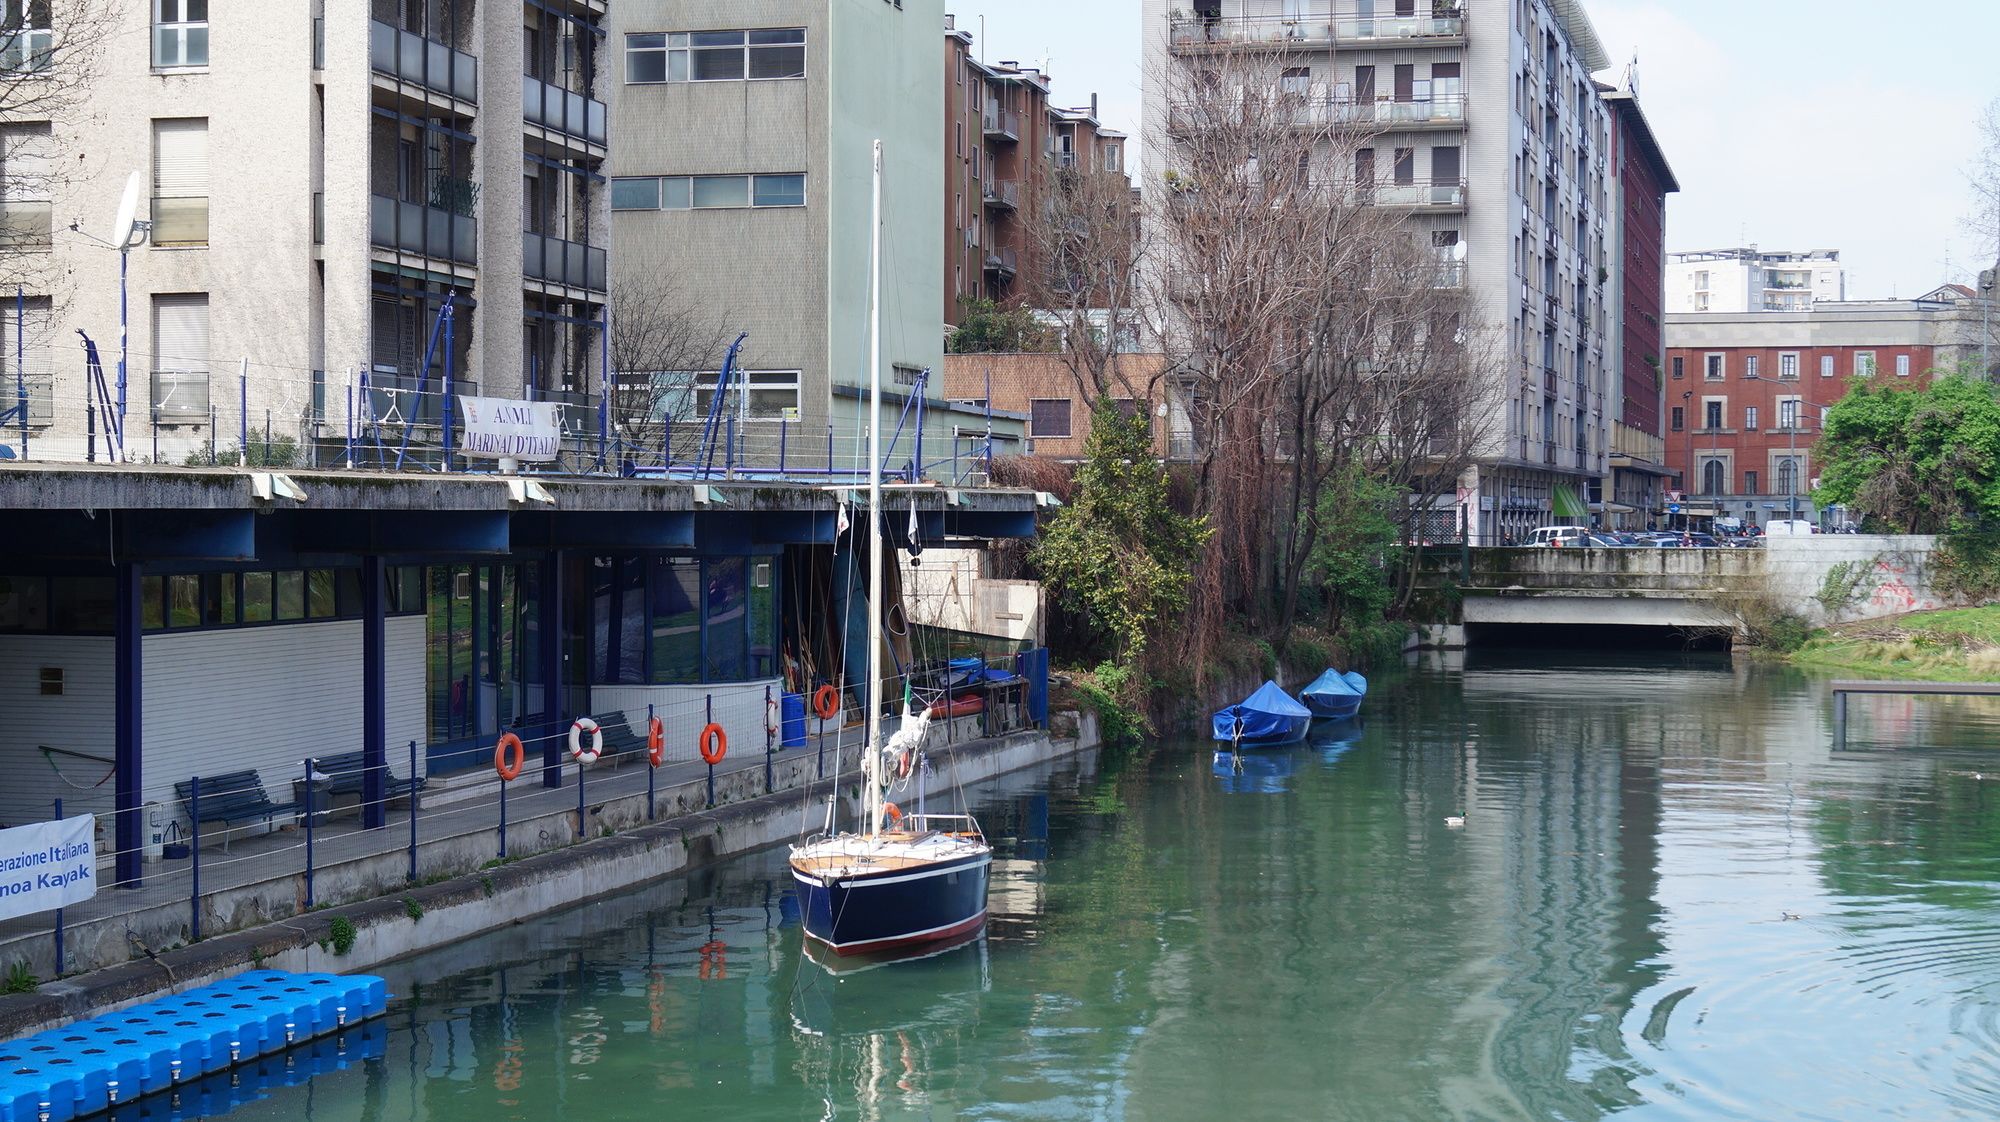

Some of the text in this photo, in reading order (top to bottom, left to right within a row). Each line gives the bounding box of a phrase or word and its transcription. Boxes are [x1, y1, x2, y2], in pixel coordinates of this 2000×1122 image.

[467, 431, 558, 455] MARINAI D'ITALIA
[0, 842, 89, 872] erazione Italiana
[0, 864, 90, 897] noa Kayak
